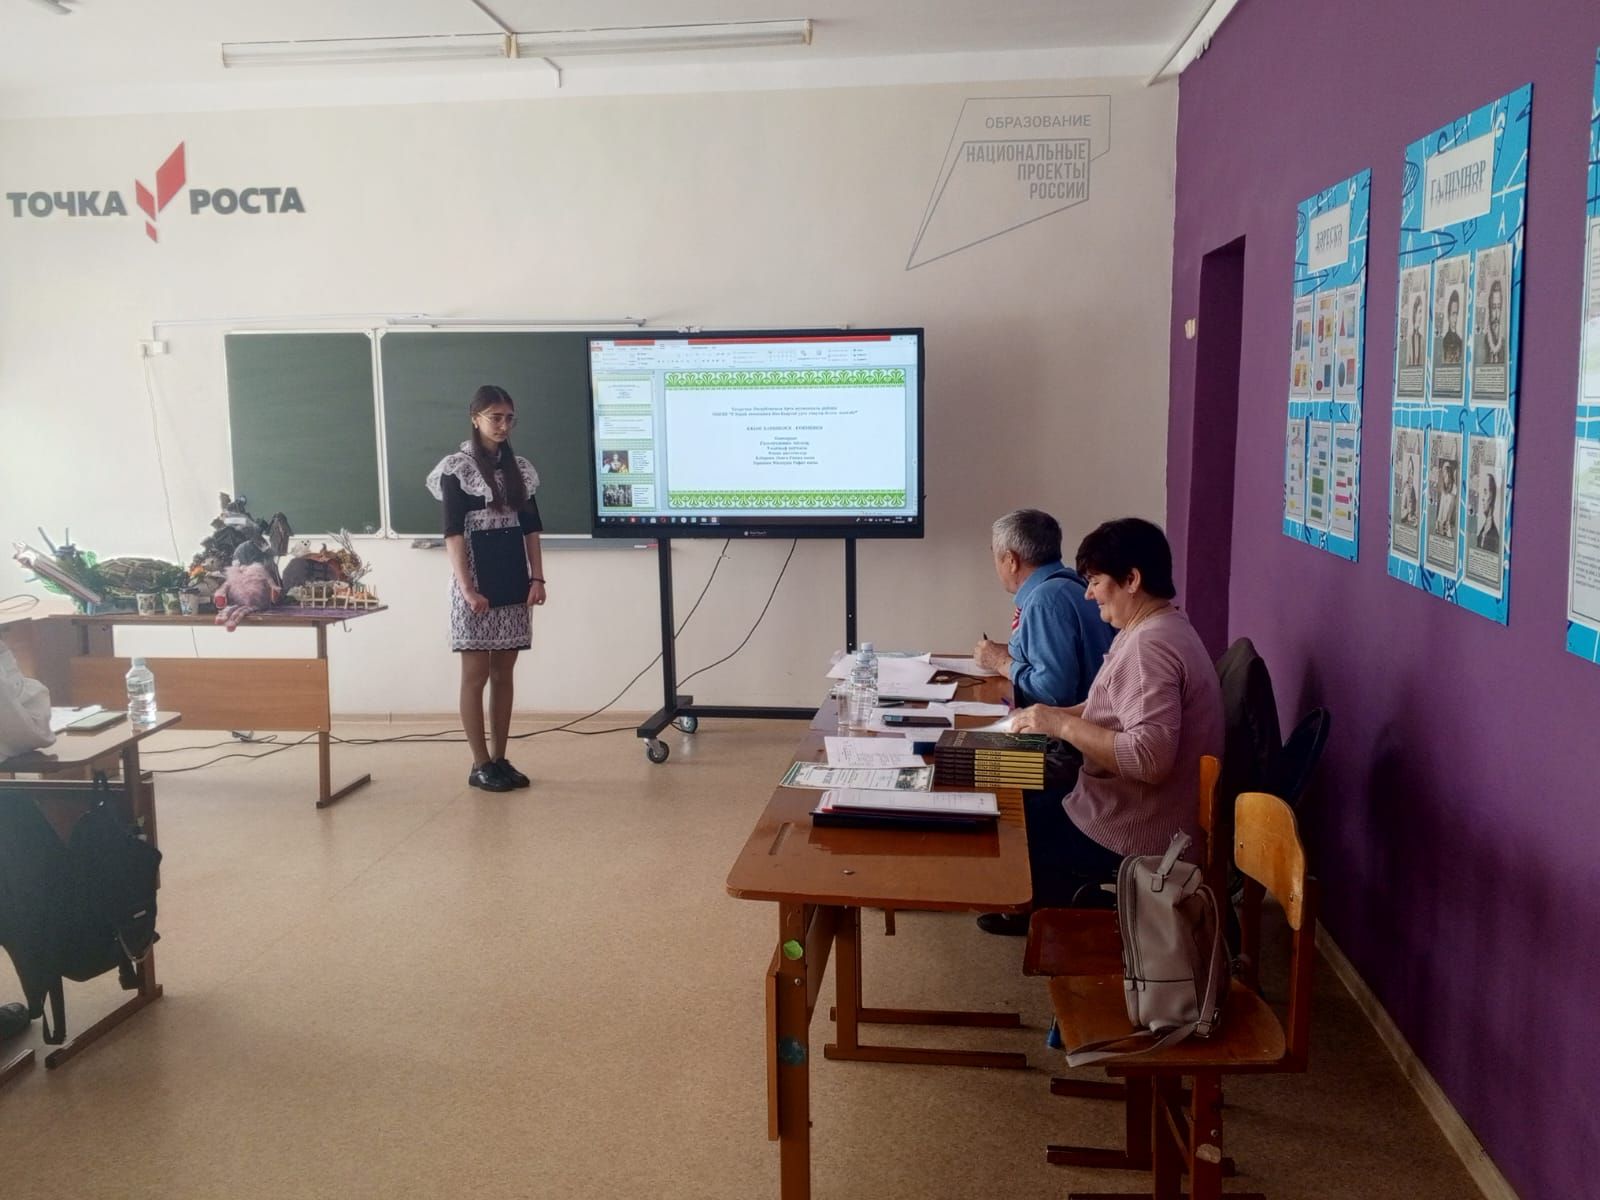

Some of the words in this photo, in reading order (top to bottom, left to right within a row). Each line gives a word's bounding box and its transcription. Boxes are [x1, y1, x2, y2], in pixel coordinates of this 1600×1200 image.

[986, 115, 1091, 129] ОБРАЗОВАНИЕ
[967, 143, 1086, 163] НАЦИОНАЛЬНЫЕ
[1018, 163, 1085, 180] ПРОЕКТЫ
[1030, 182, 1085, 199] РОССИИ
[6, 190, 128, 218] ТОЧКА
[189, 187, 306, 215] РОСТА
